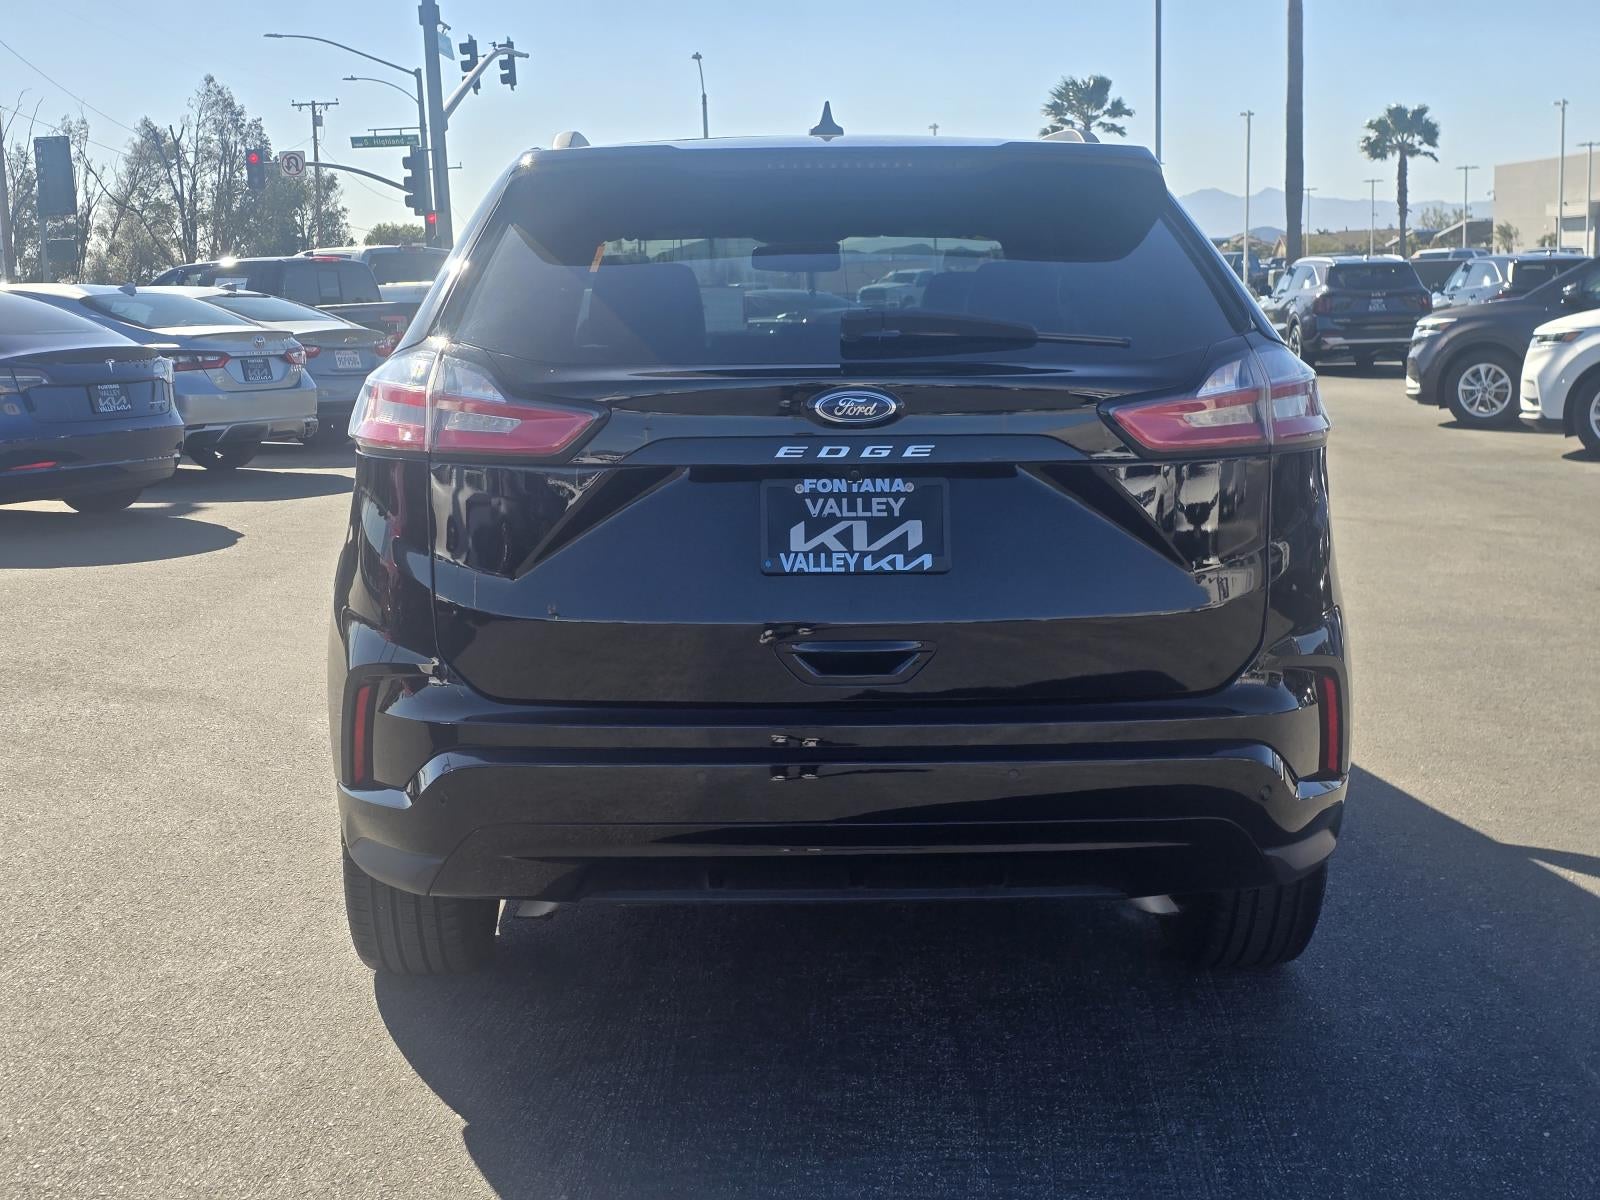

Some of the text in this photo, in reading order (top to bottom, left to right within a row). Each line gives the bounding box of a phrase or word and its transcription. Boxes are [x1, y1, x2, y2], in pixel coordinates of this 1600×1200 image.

[833, 397, 877, 416] Ford
[774, 444, 936, 458] EDGE
[803, 478, 906, 493] FONTANA
[805, 497, 906, 518] VALLEY
[790, 519, 923, 551] KIA
[779, 552, 933, 573] VALLEY KIA
